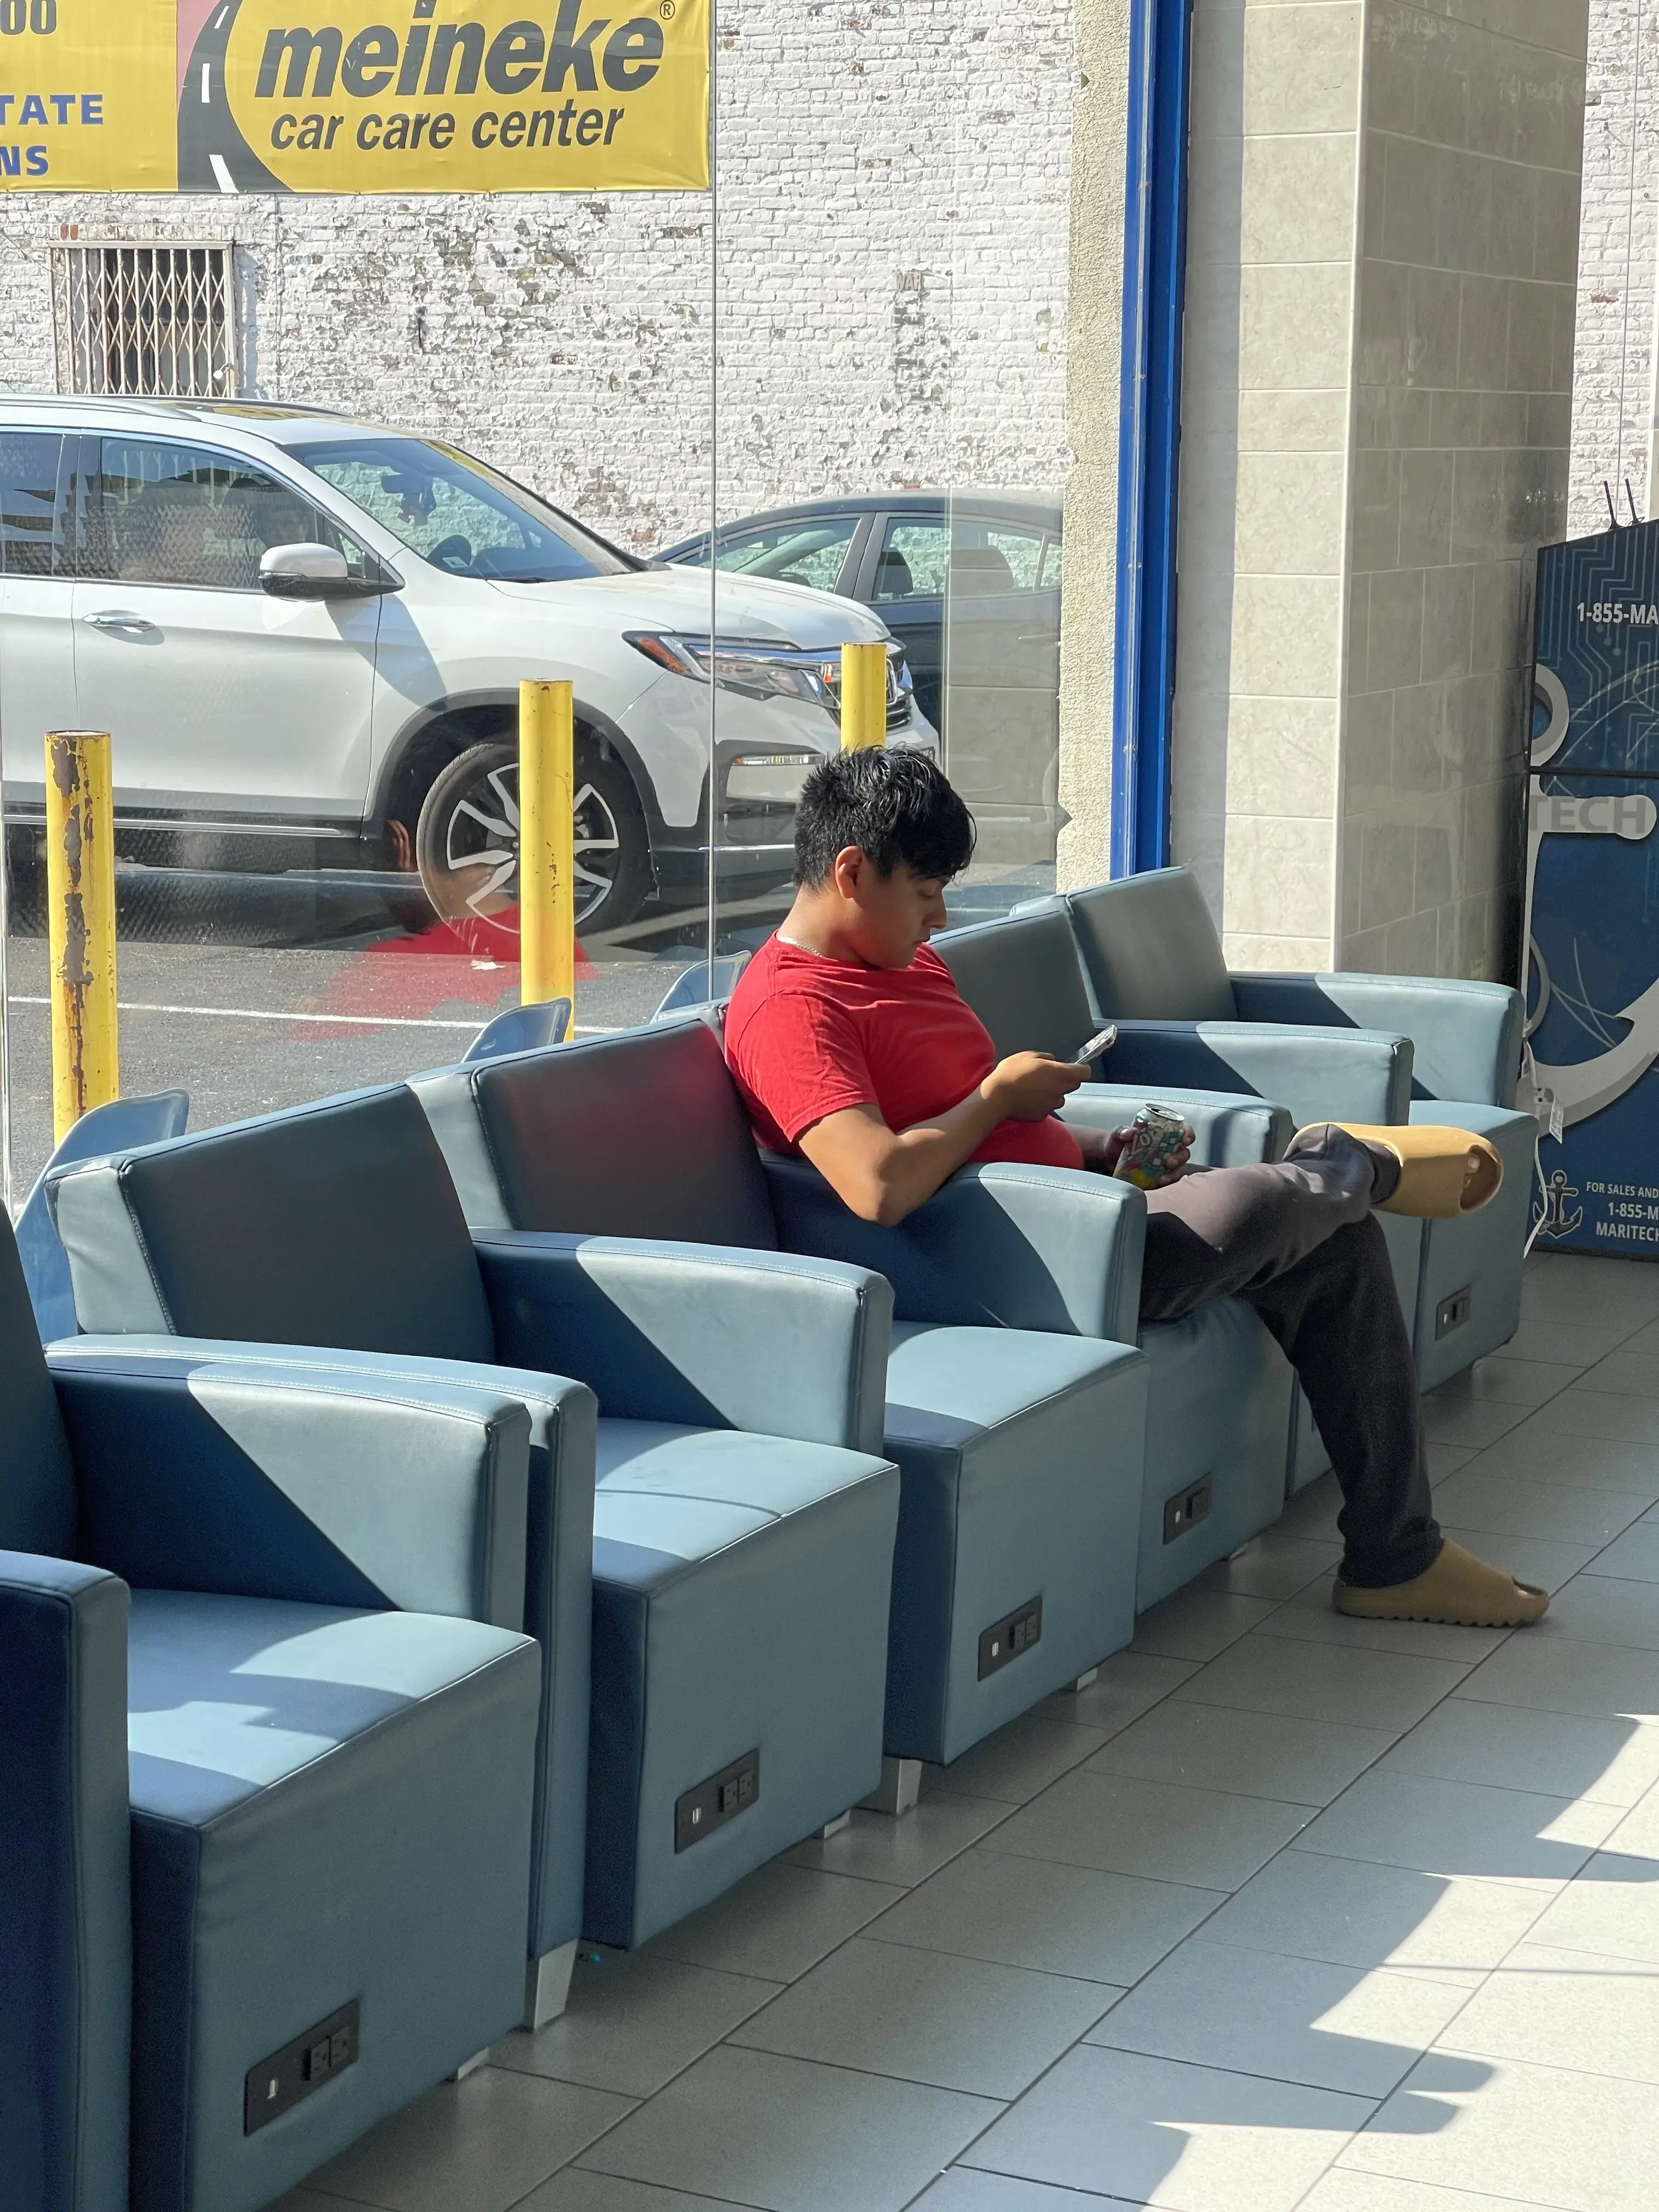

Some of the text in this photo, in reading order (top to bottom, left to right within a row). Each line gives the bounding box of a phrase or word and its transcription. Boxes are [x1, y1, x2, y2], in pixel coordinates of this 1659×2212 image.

[0, 94, 103, 125] TATE
[270, 99, 625, 150] car care center
[0, 145, 48, 176] NS
[1577, 602, 1659, 624] 1-855-MA
[1529, 795, 1646, 834] TECH
[1585, 1181, 1659, 1199] FOR SALES AND
[1607, 1201, 1659, 1220] 1-855-M
